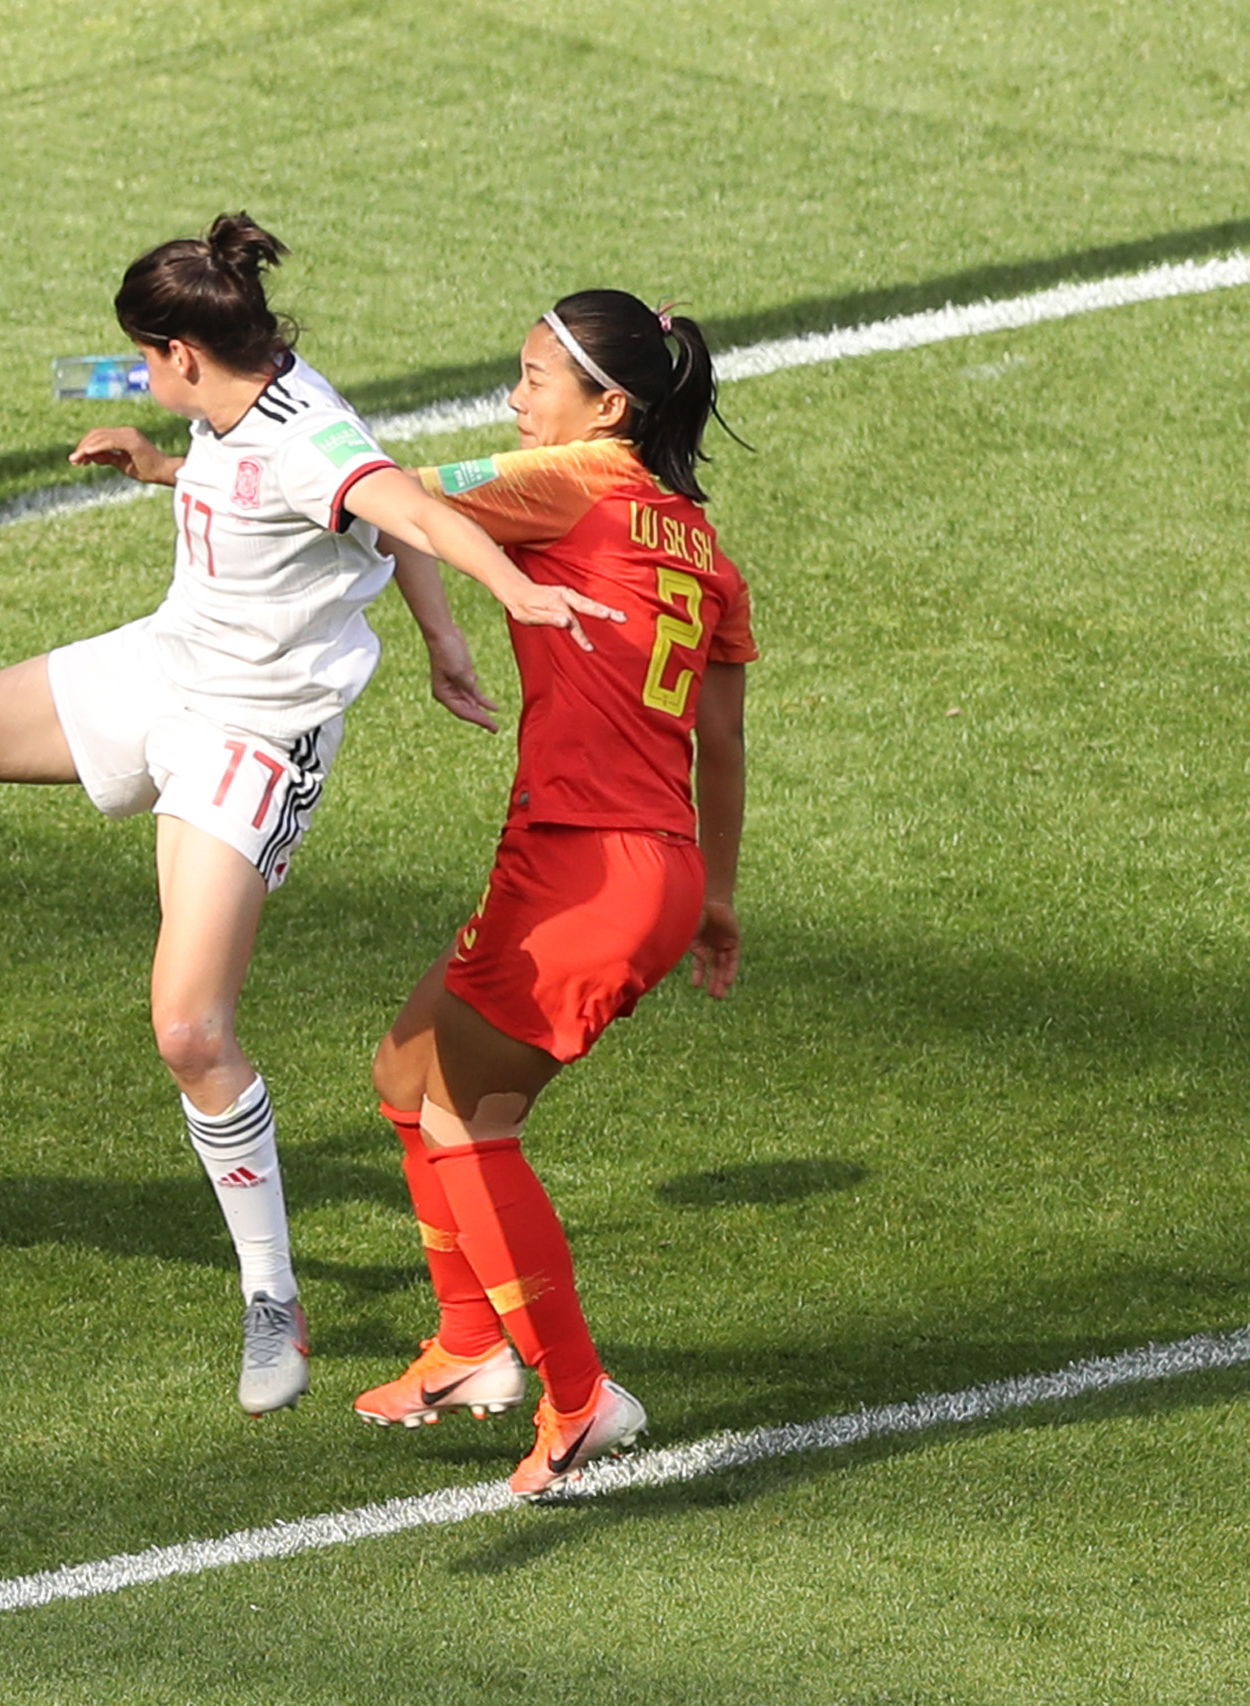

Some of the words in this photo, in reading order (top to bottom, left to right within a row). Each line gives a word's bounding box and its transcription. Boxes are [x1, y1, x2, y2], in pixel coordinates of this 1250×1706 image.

[181, 492, 216, 577] 17
[630, 500, 658, 549] LIU
[643, 567, 703, 718] 2
[211, 739, 286, 829] 17
